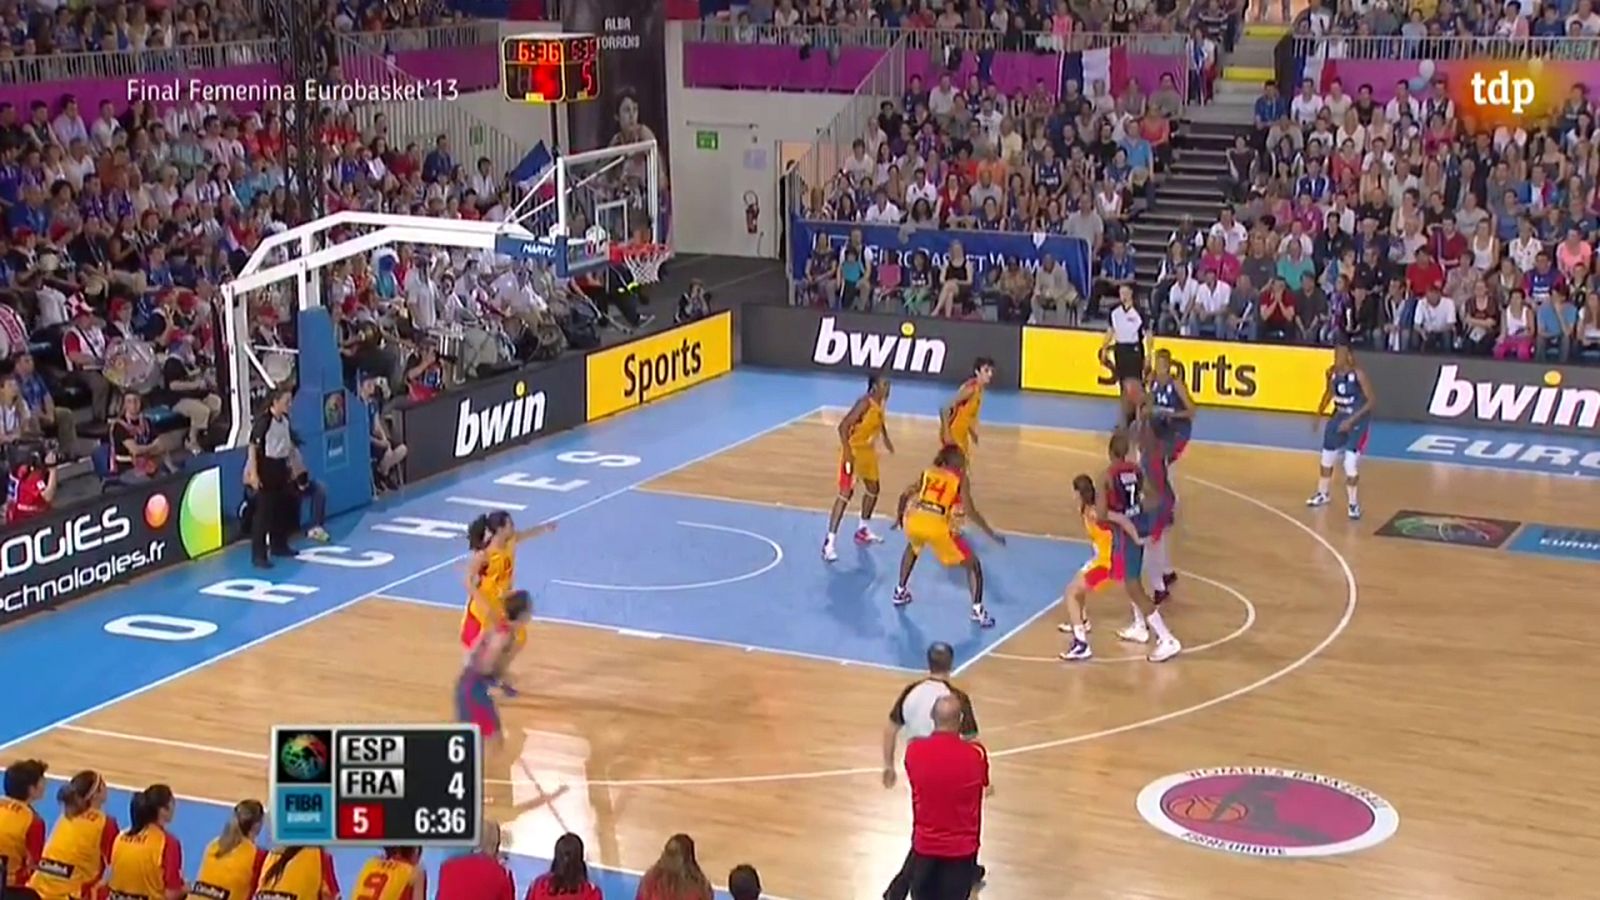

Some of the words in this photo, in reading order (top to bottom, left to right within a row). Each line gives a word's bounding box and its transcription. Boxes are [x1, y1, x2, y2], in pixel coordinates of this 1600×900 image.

[518, 41, 561, 62] 6:36
[604, 16, 631, 31] ALBA
[623, 337, 702, 405] Sports
[814, 317, 947, 374] bwin
[1097, 344, 1257, 396] Sorts
[454, 380, 546, 458] bwin
[1428, 363, 1600, 429] bwin
[0, 506, 131, 578] OGIES
